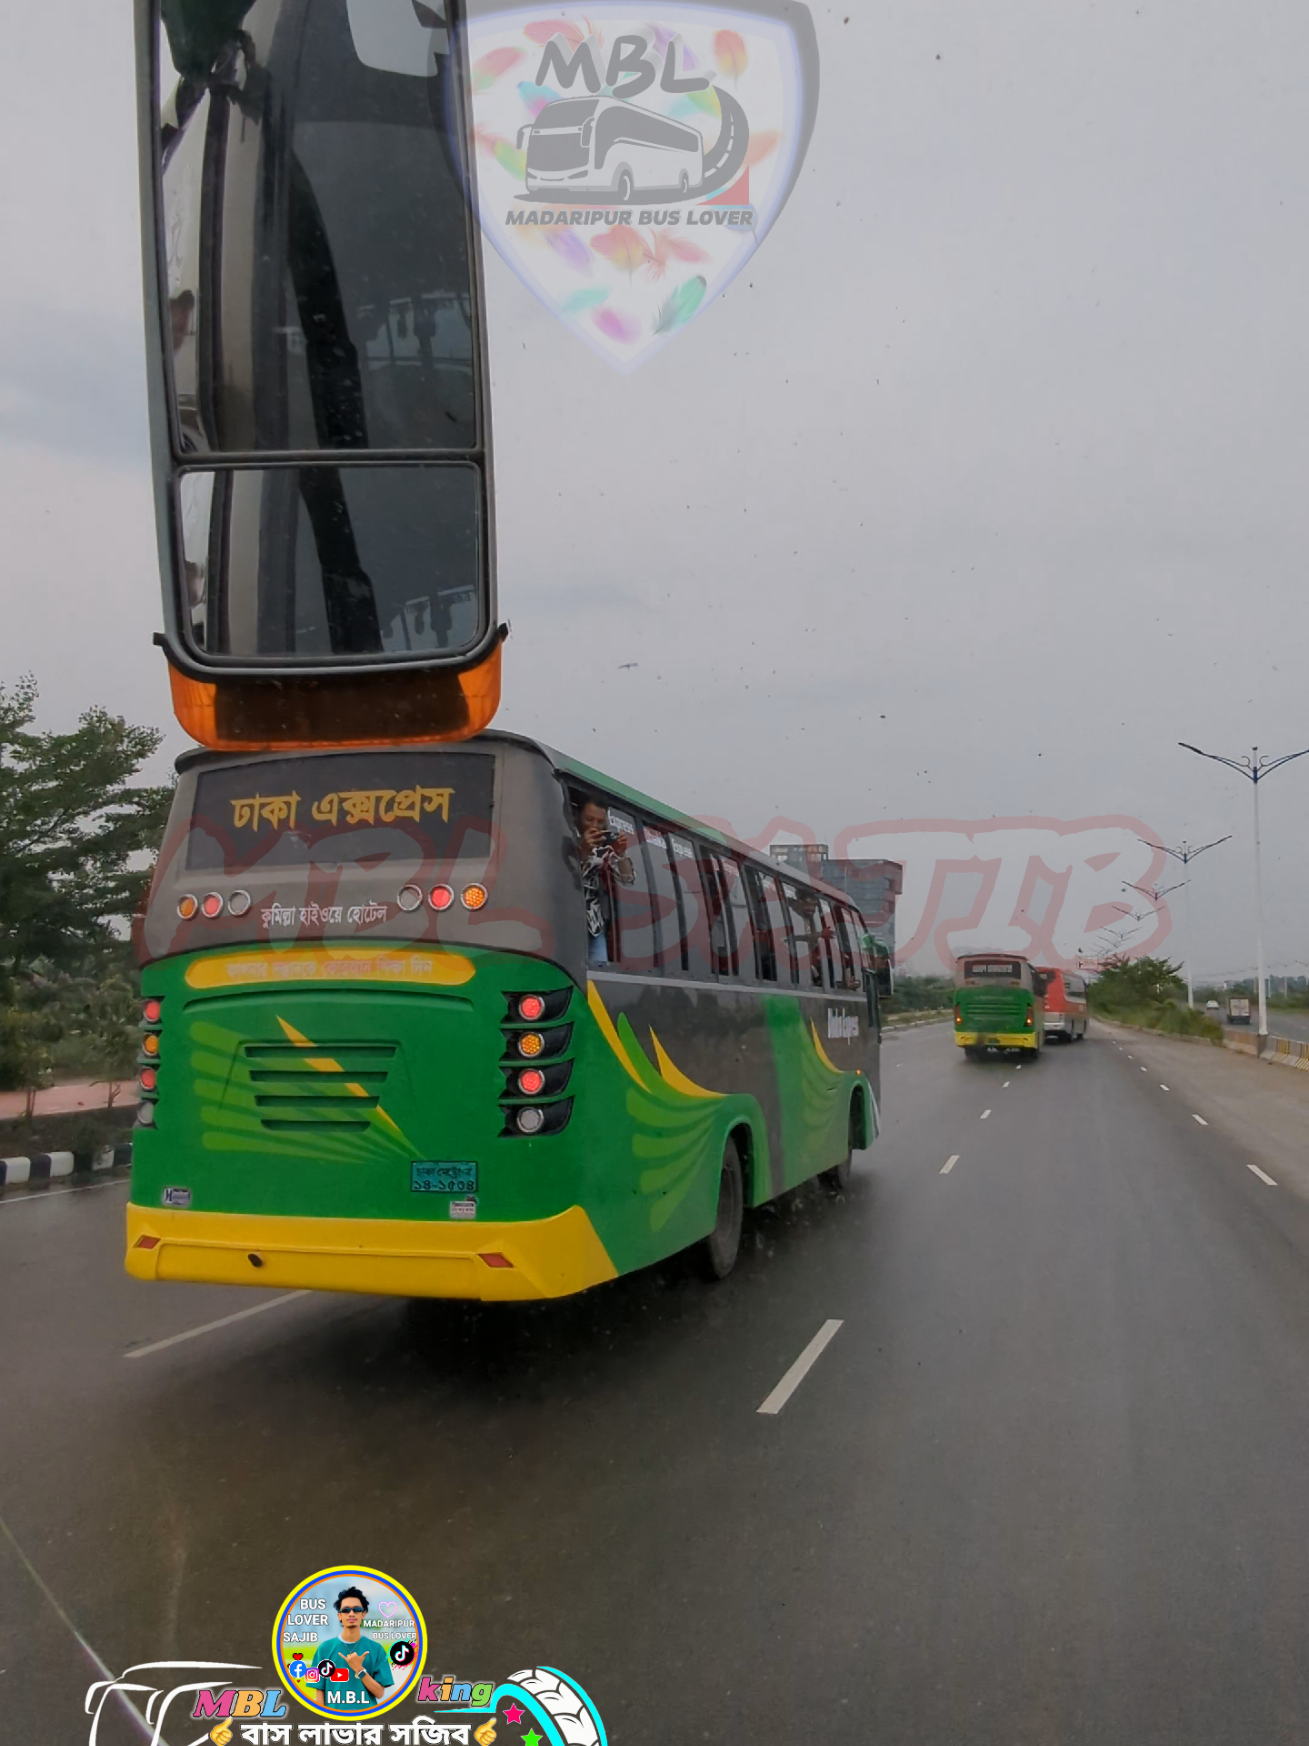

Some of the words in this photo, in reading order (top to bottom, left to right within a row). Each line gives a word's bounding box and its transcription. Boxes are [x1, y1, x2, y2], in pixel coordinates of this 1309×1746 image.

[230, 790, 301, 832] ঢাকা
[312, 784, 455, 827] এক্সপ্রেস
[261, 902, 296, 929] কুমিল্লা
[347, 900, 388, 926] হোটেল
